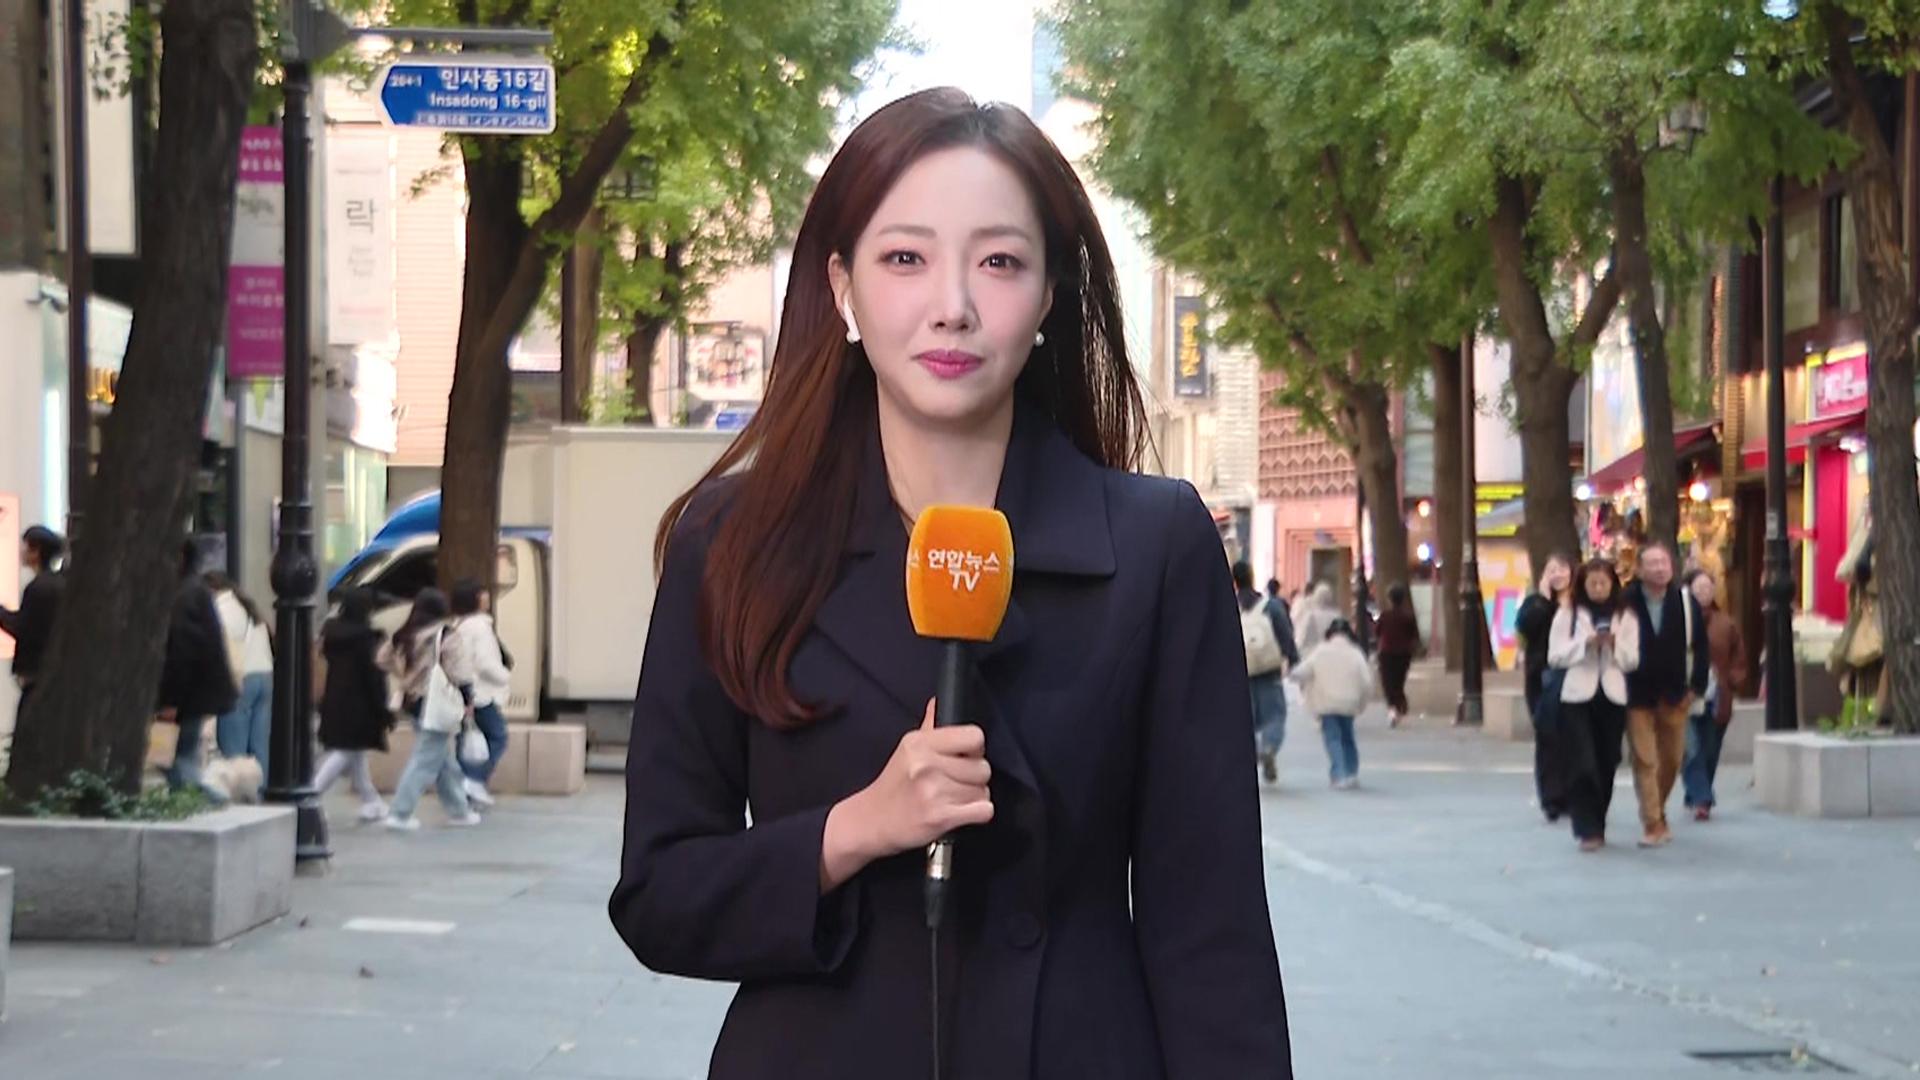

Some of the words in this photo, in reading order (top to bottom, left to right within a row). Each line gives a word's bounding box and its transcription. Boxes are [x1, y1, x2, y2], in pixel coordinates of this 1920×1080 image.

[440, 68, 546, 91] 인사동16길
[429, 93, 498, 111] Insadong
[504, 93, 546, 111] 16-gil
[927, 548, 1000, 571] 연합뉴스
[948, 570, 981, 593] TV
